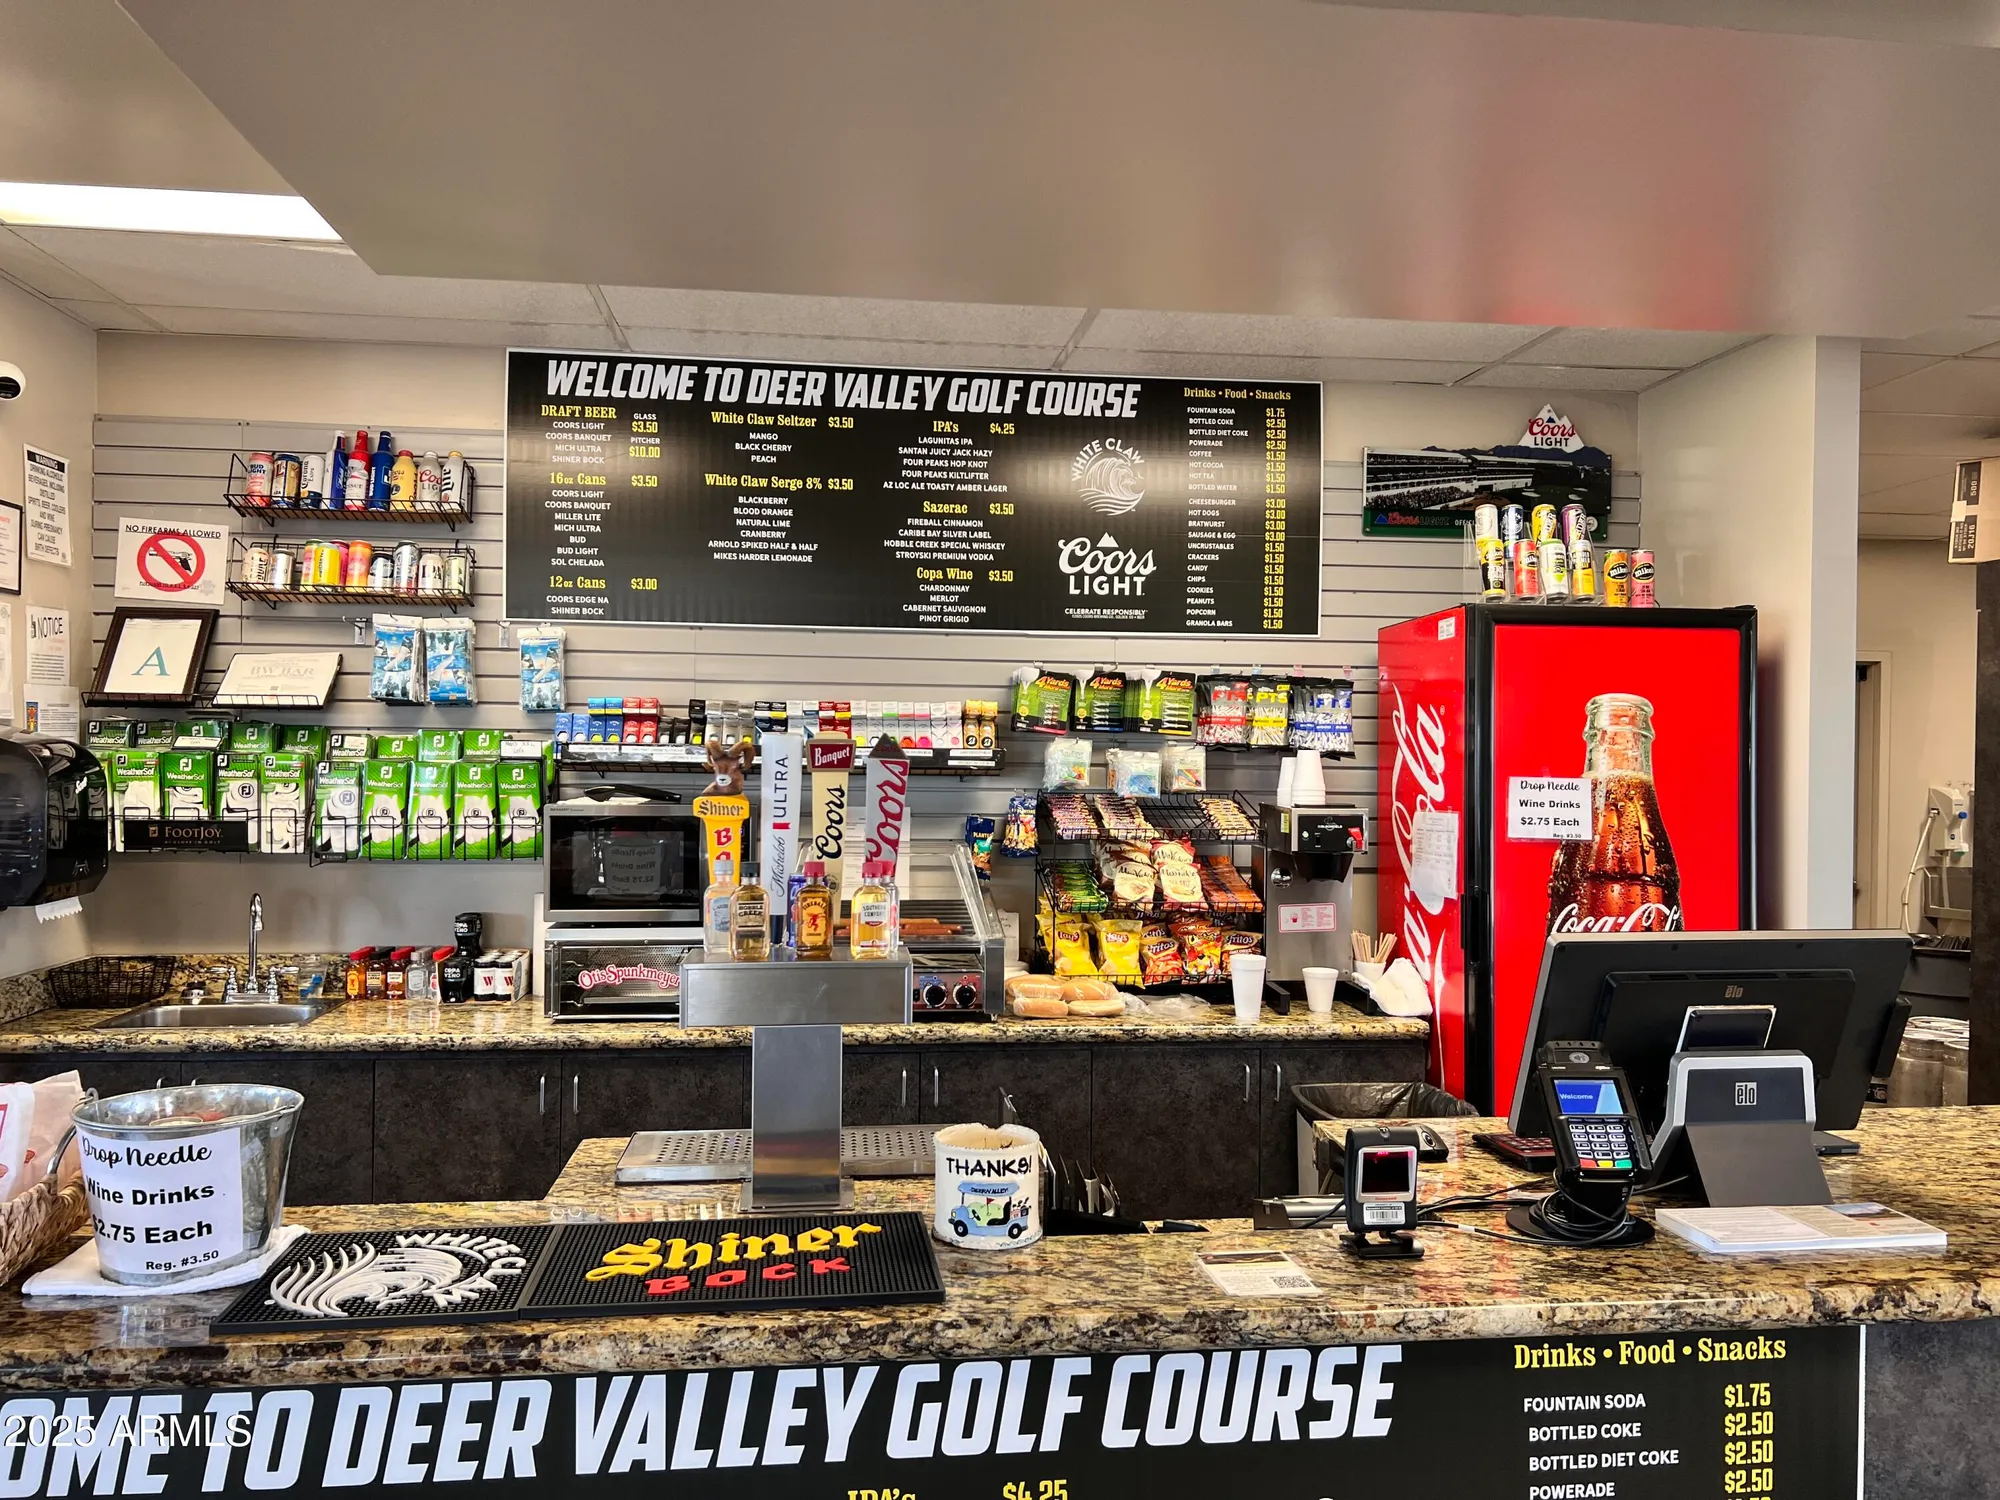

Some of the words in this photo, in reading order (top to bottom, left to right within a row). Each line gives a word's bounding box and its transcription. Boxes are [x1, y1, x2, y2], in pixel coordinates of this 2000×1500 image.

[547, 360, 698, 400] WELCOME
[704, 366, 743, 403] TO
[746, 368, 827, 406] DEER
[834, 372, 945, 411] VALLEY
[947, 378, 1024, 414] GOLF
[1026, 380, 1141, 418] COURSE
[1184, 388, 1216, 397] Drinks
[1225, 389, 1246, 398] Food
[1256, 390, 1290, 400] Snacks
[542, 405, 581, 417] DRAFT
[585, 406, 616, 418] BEER
[711, 412, 744, 424] White
[747, 413, 774, 425] Claw
[778, 414, 816, 426] Seltzer
[1266, 408, 1284, 417] $1.75
[632, 421, 658, 432] $3.50
[828, 417, 853, 428] $3.50
[933, 421, 958, 432] IPA's
[990, 423, 1014, 434] $4.25
[1266, 419, 1286, 428] $2.50
[1528, 418, 1575, 437] Coors
[918, 437, 959, 445] LAGUNITAS
[1534, 437, 1569, 447] LIGHT
[630, 446, 660, 458] $10.00
[1072, 440, 1102, 482] WHITE
[1105, 437, 1145, 465] CLAW
[551, 472, 573, 484] 16oz
[578, 473, 606, 485] Cans
[632, 475, 657, 487] $3.50
[705, 474, 737, 486] White
[741, 475, 768, 487] Claw
[771, 476, 803, 491] Serge
[806, 478, 822, 489] 8%
[924, 501, 967, 513] Sazerac
[1387, 512, 1420, 526] Coors
[1420, 512, 1449, 526] LIGHT
[125, 524, 139, 532] NO
[141, 525, 181, 535] FIREARMS
[182, 528, 222, 538] ALLOWED
[1058, 538, 1156, 575] Coors
[550, 576, 573, 588] 12oz
[577, 576, 606, 588] Cans
[917, 567, 943, 581] Copa
[946, 568, 972, 580] Wine
[631, 578, 657, 590] $3.00
[1070, 575, 1146, 596] LIGHT
[37, 616, 63, 637] NOTICE
[131, 646, 171, 676] A
[1046, 677, 1070, 687] Yards
[1100, 677, 1122, 686] Yards
[1256, 692, 1288, 703] PTS
[814, 746, 850, 767] Banquet
[167, 772, 204, 780] WeatherSof
[219, 769, 254, 778] WeatherSof
[367, 780, 403, 788] WeatherSof
[774, 757, 788, 818] ULTRA
[1521, 780, 1546, 792] Drop
[1548, 782, 1580, 791] Needle
[698, 800, 744, 816] Shiner
[816, 784, 846, 860] Coors
[1521, 817, 1549, 825] $2.75
[1554, 818, 1579, 826] Each
[771, 836, 787, 898] Michelob
[82, 1136, 123, 1168] Drop
[126, 1145, 212, 1166] Needle
[946, 1155, 1032, 1177] THANKS!
[86, 1175, 123, 1203] Wine
[132, 1185, 215, 1205] Drinks
[92, 1214, 136, 1243] $2.75
[145, 1221, 212, 1243] Each
[396, 1232, 521, 1259] WHITE
[585, 1220, 883, 1282] Shiner
[146, 1261, 176, 1271] Reg.
[181, 1250, 219, 1266] #3.50
[645, 1256, 852, 1296] BOCK
[1514, 1343, 1596, 1368] Drinks
[1619, 1340, 1675, 1364] Food
[1698, 1336, 1786, 1362] Snacks
[1524, 1395, 1600, 1412] FOUNTAIN
[1604, 1394, 1646, 1409] SODA
[1725, 1383, 1770, 1408] $1.75
[202, 1389, 313, 1492] TO
[322, 1379, 552, 1487] DEER
[575, 1365, 881, 1475] VALLEY
[886, 1356, 1091, 1459] GOLF
[1101, 1344, 1402, 1448] COURSE
[1725, 1411, 1773, 1436] $2.50
[1529, 1425, 1597, 1441] BOTTLED
[1601, 1423, 1641, 1438] COKE
[1530, 1454, 1598, 1471] BOTTLED
[1602, 1452, 1635, 1467] DIET
[1639, 1450, 1679, 1465] COKE
[1725, 1440, 1773, 1465] $2.50
[1725, 1468, 1773, 1493] $2.50
[1530, 1482, 1615, 1500] POWERADE
